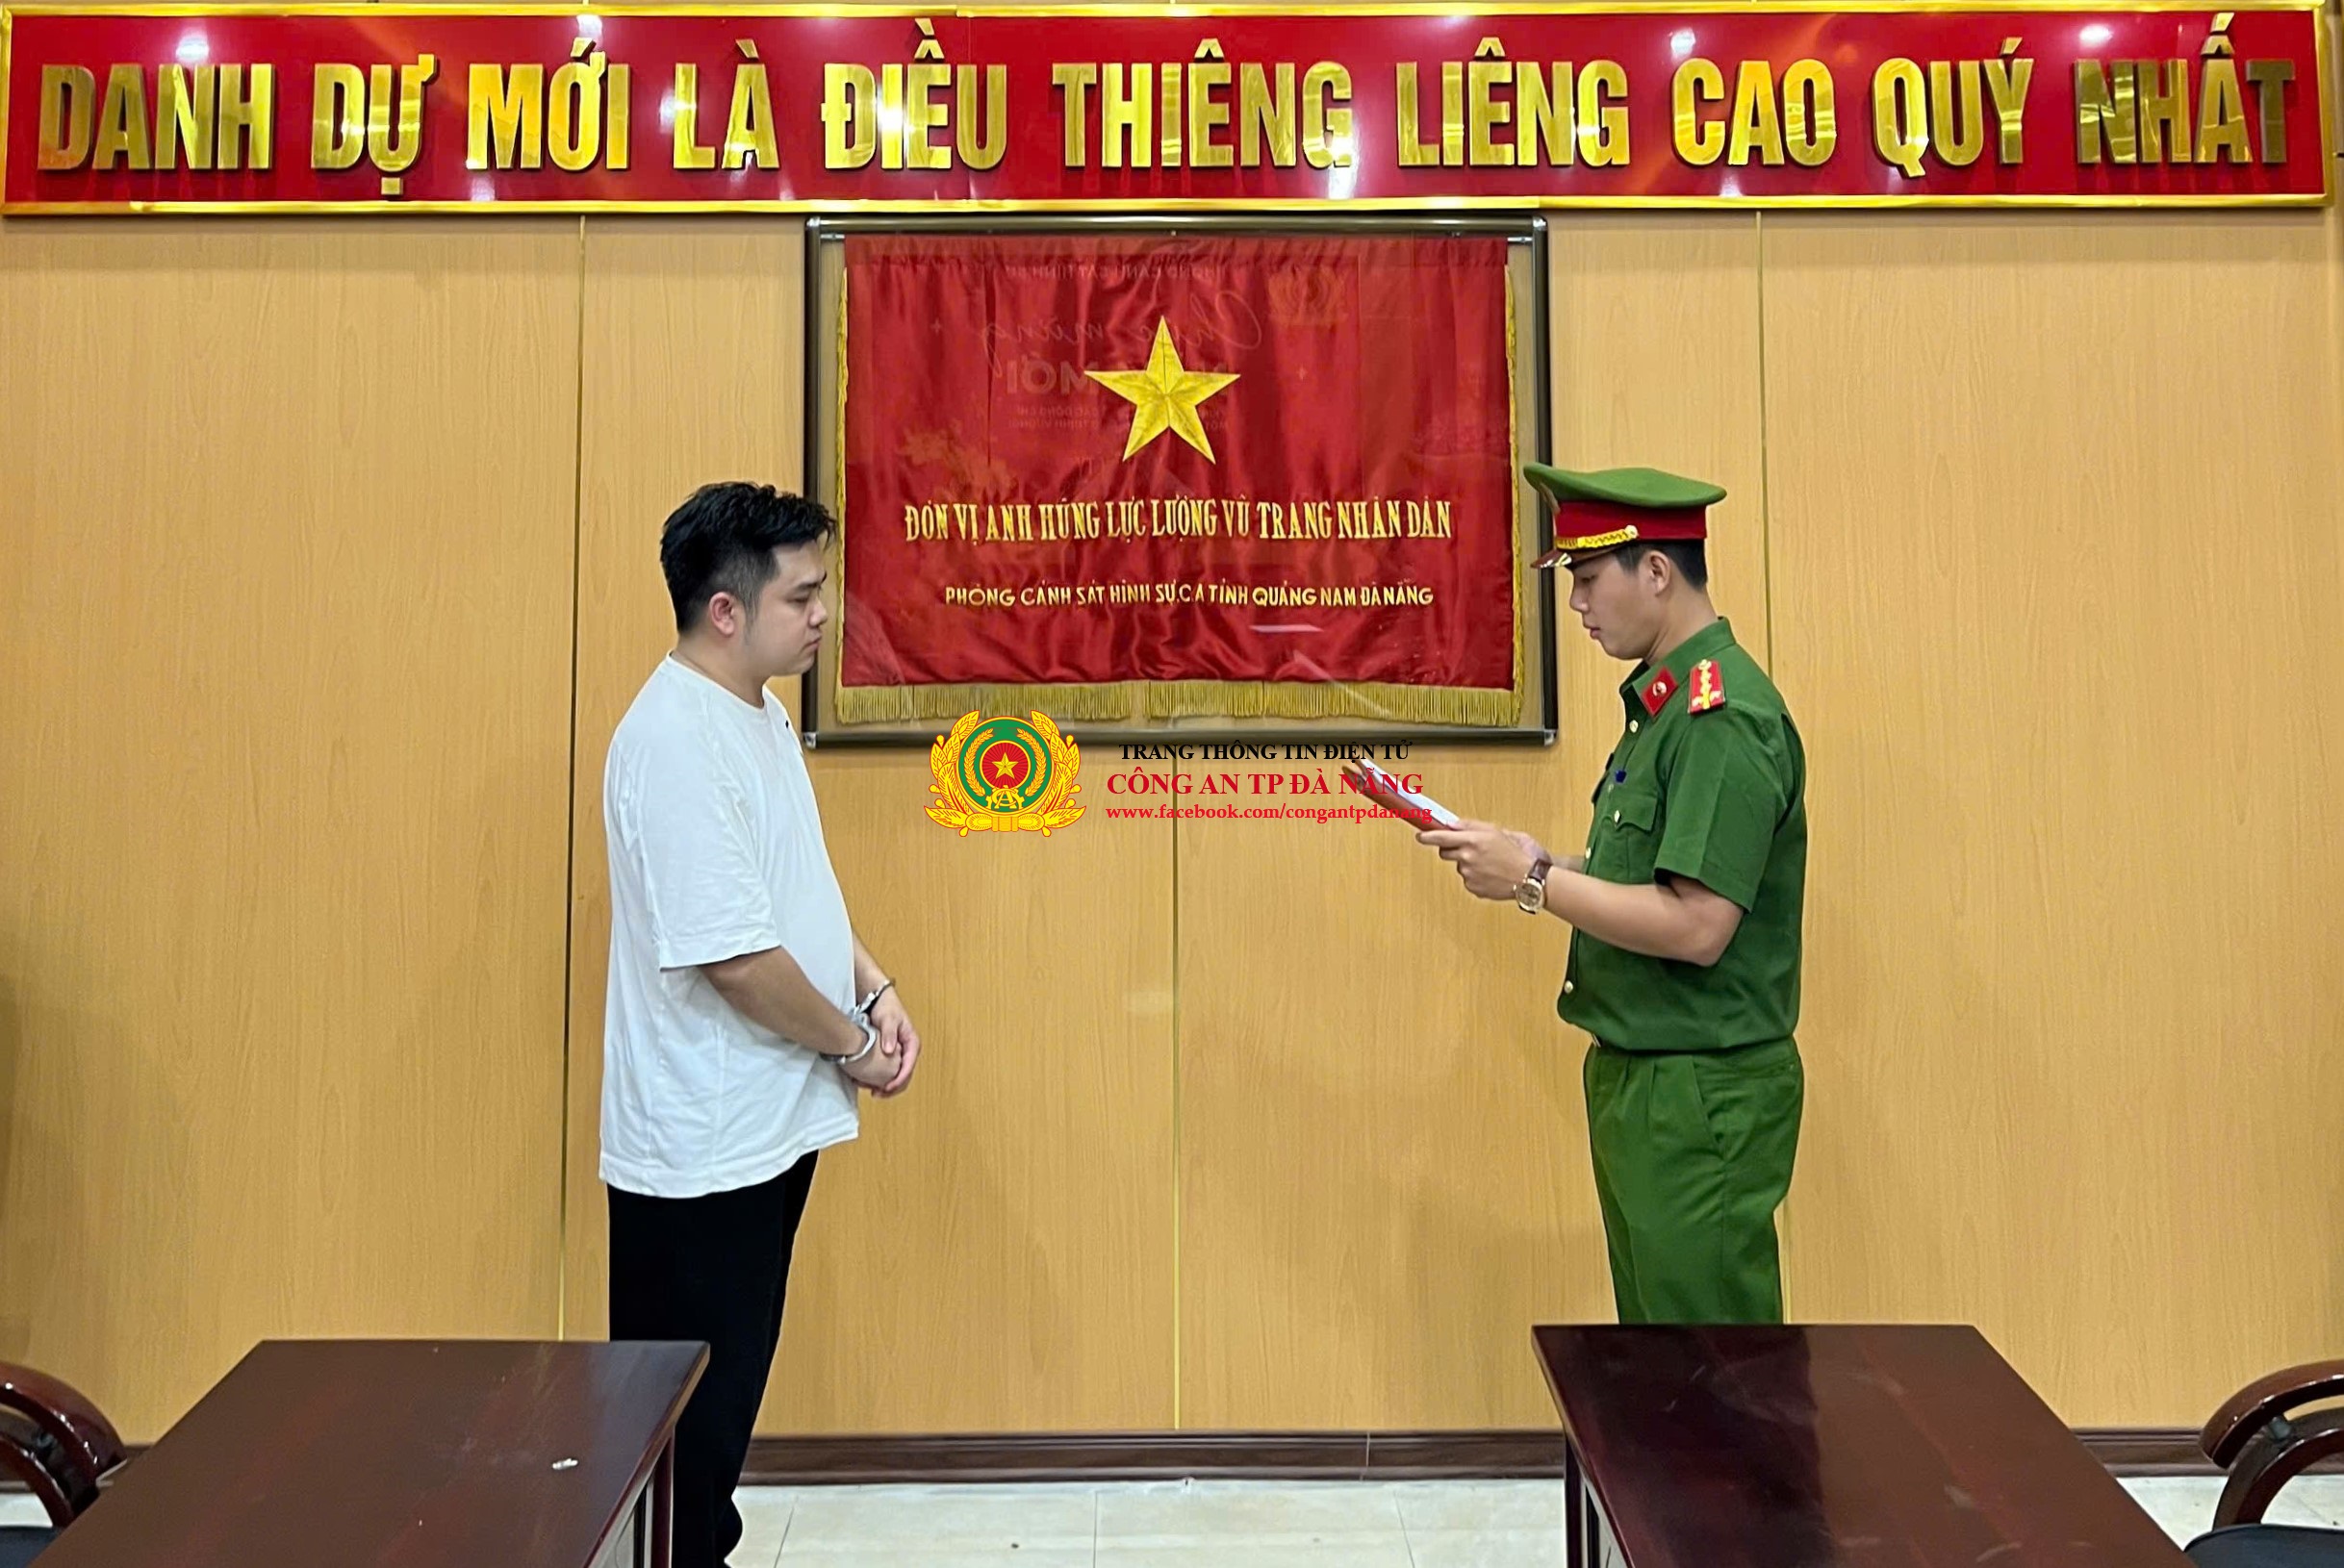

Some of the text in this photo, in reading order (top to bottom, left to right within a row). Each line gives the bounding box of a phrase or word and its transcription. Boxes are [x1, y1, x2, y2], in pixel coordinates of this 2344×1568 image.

[37, 12, 2295, 194] DANH DỰ MỚI LÀ ĐIỀU THIÊNG LIÊNG CAO QUÝ NHẤT
[953, 503, 980, 545] VỊ
[985, 504, 1034, 542] ANH
[1105, 495, 1146, 544] LỰC
[1256, 500, 1332, 539] TRANG
[1320, 587, 1356, 607] NAM
